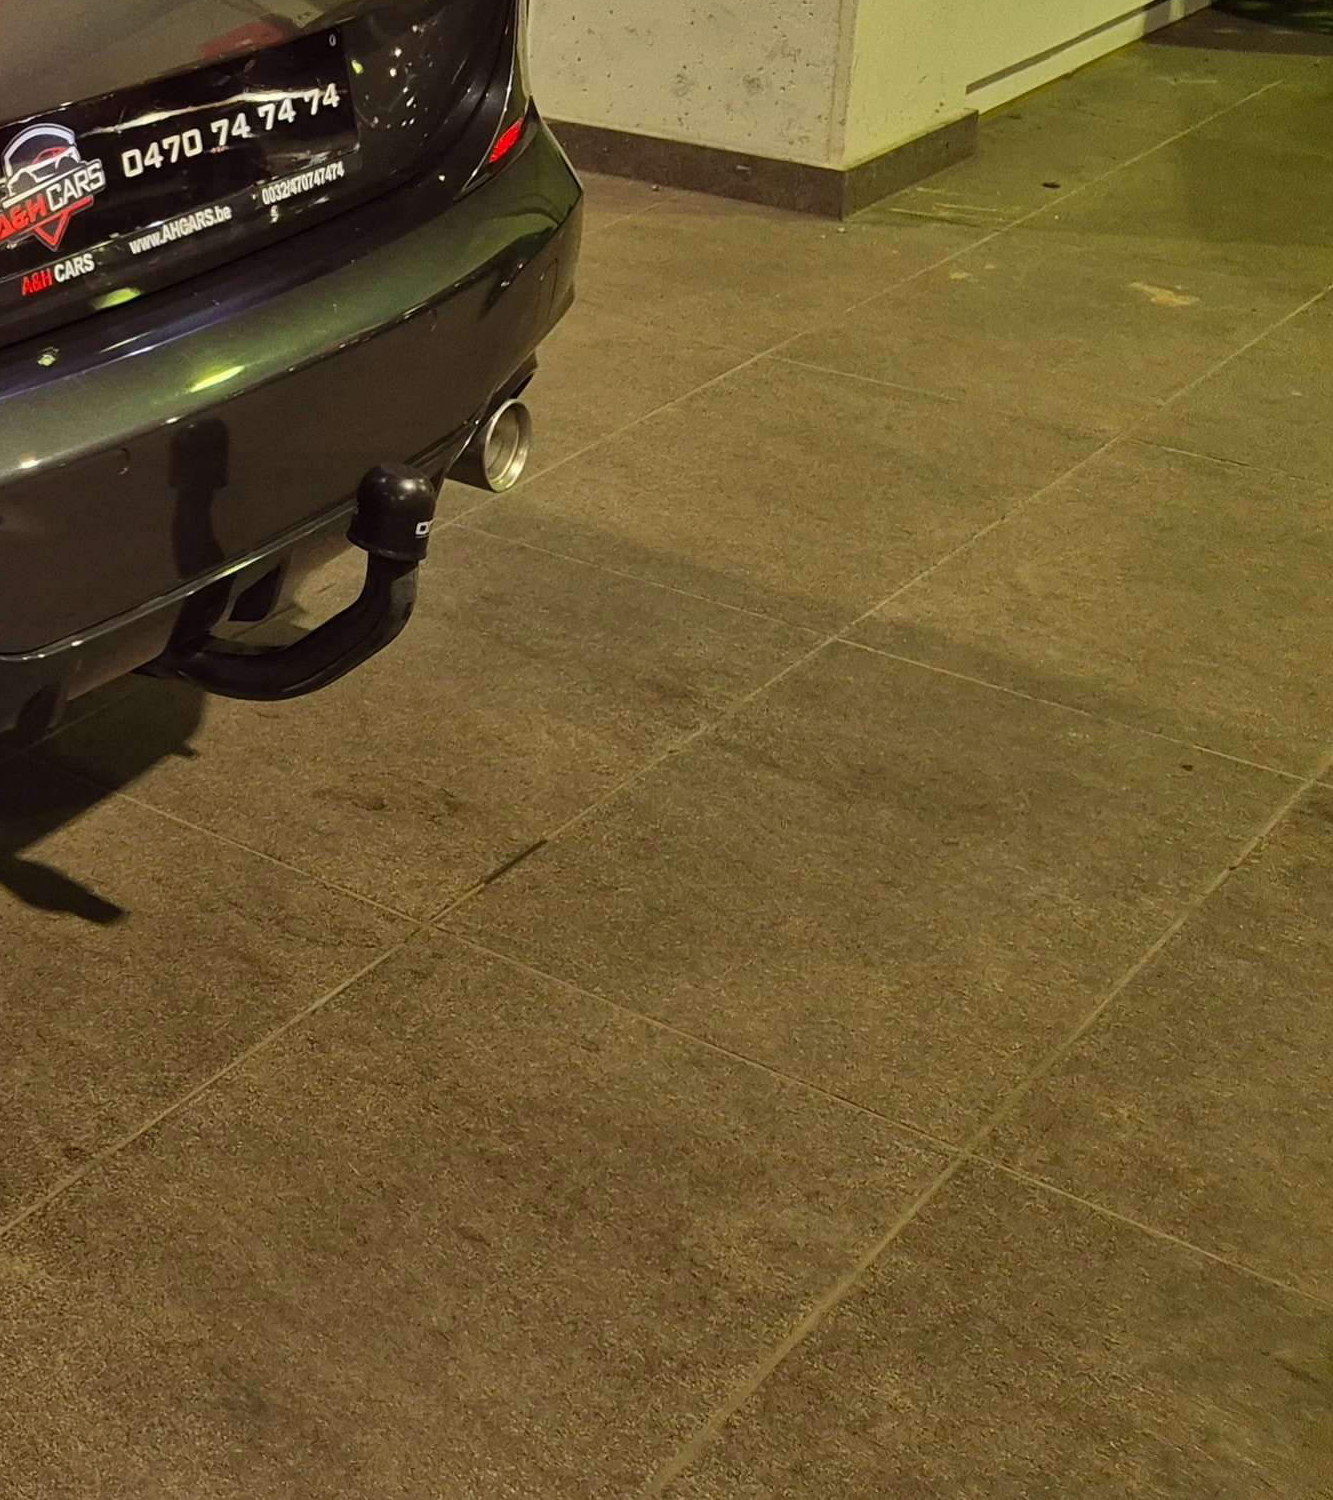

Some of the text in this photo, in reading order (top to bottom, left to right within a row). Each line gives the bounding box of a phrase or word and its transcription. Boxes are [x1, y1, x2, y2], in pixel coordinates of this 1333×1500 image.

[121, 83, 341, 178] 0470 74 74 74
[46, 162, 105, 212] CARS
[261, 161, 345, 206] 0032/470747474
[129, 205, 233, 255] www.AHCARS.be
[53, 253, 95, 283] CARS
